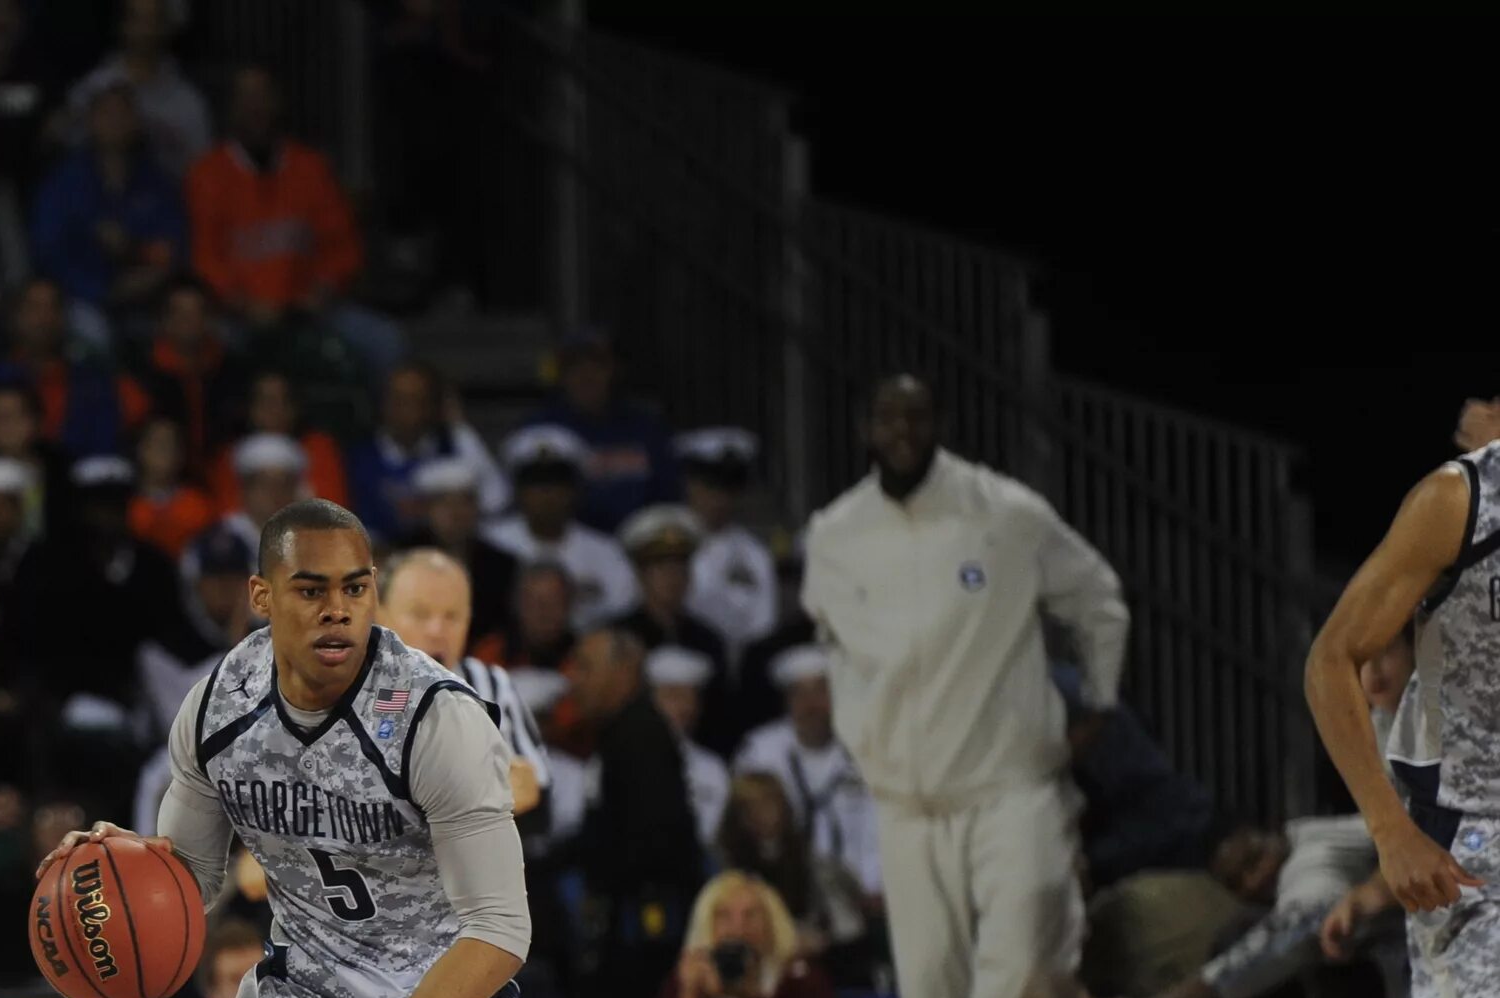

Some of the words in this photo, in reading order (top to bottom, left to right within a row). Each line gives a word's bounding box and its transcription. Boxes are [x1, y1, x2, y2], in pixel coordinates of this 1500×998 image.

[217, 779, 403, 844] GEORGETOWN
[71, 859, 120, 982] Wilson
[307, 847, 378, 922] 5
[36, 896, 70, 979] NCAA
